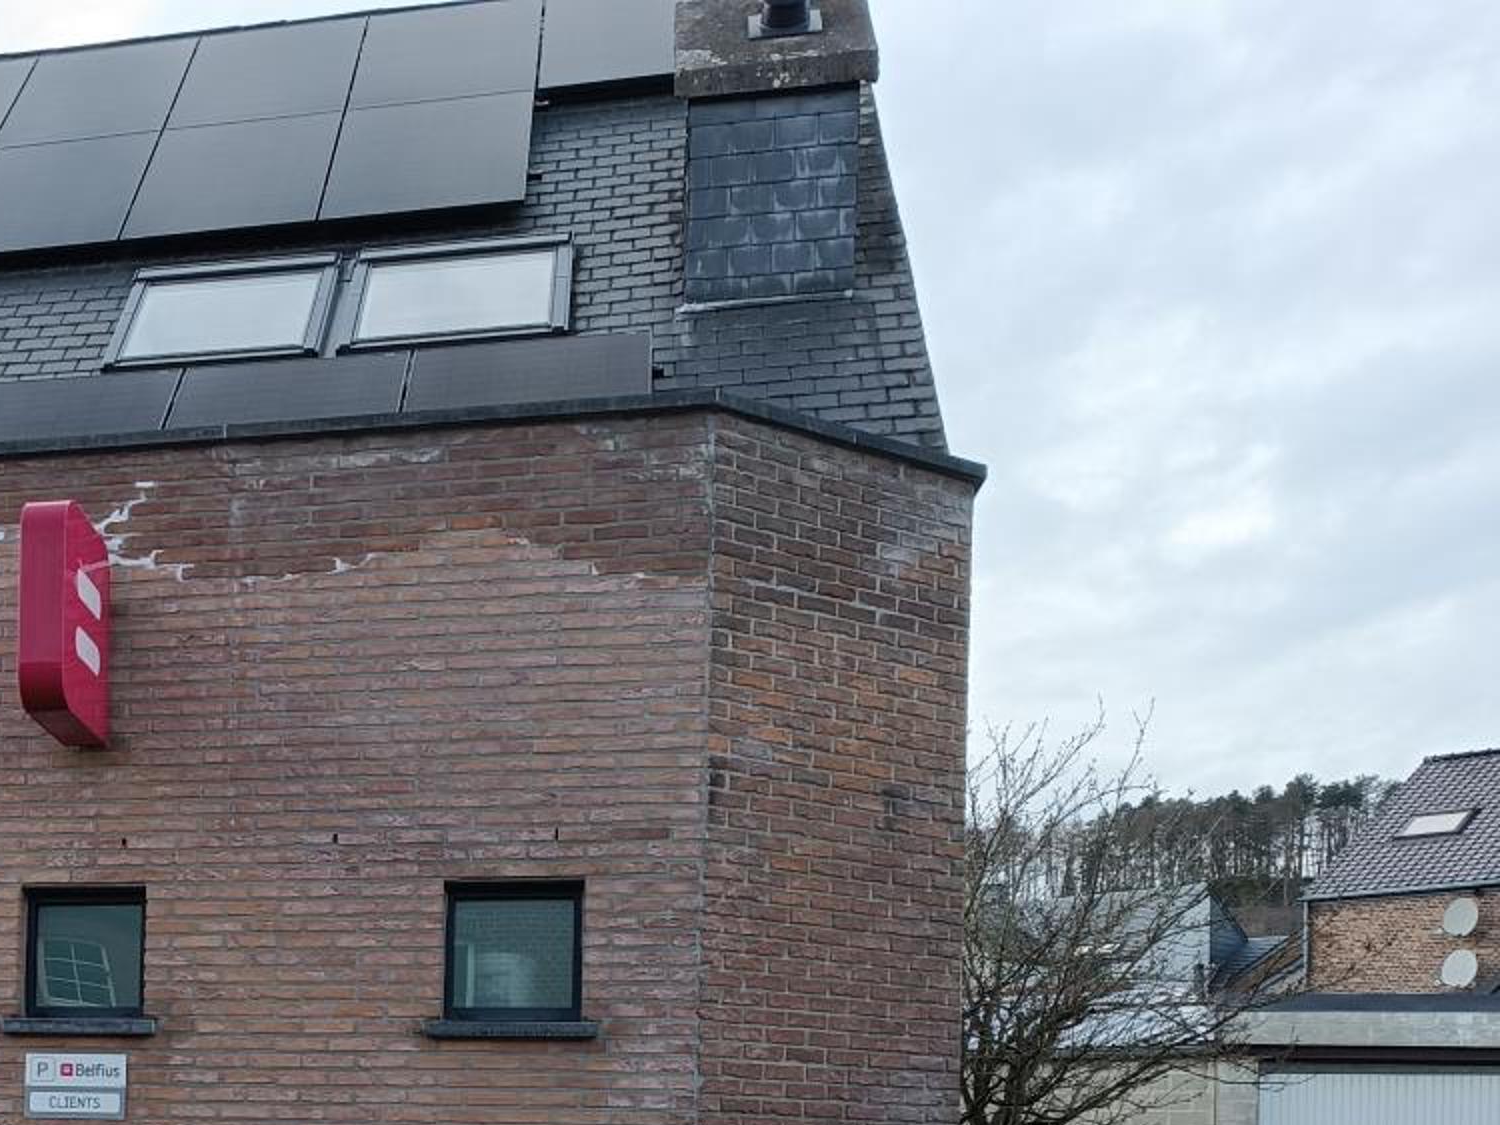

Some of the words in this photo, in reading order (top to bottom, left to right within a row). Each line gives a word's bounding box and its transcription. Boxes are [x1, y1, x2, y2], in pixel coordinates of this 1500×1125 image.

[37, 1061, 49, 1077] P
[75, 1063, 120, 1077] Belfius
[49, 1095, 100, 1109] CLIENTS
